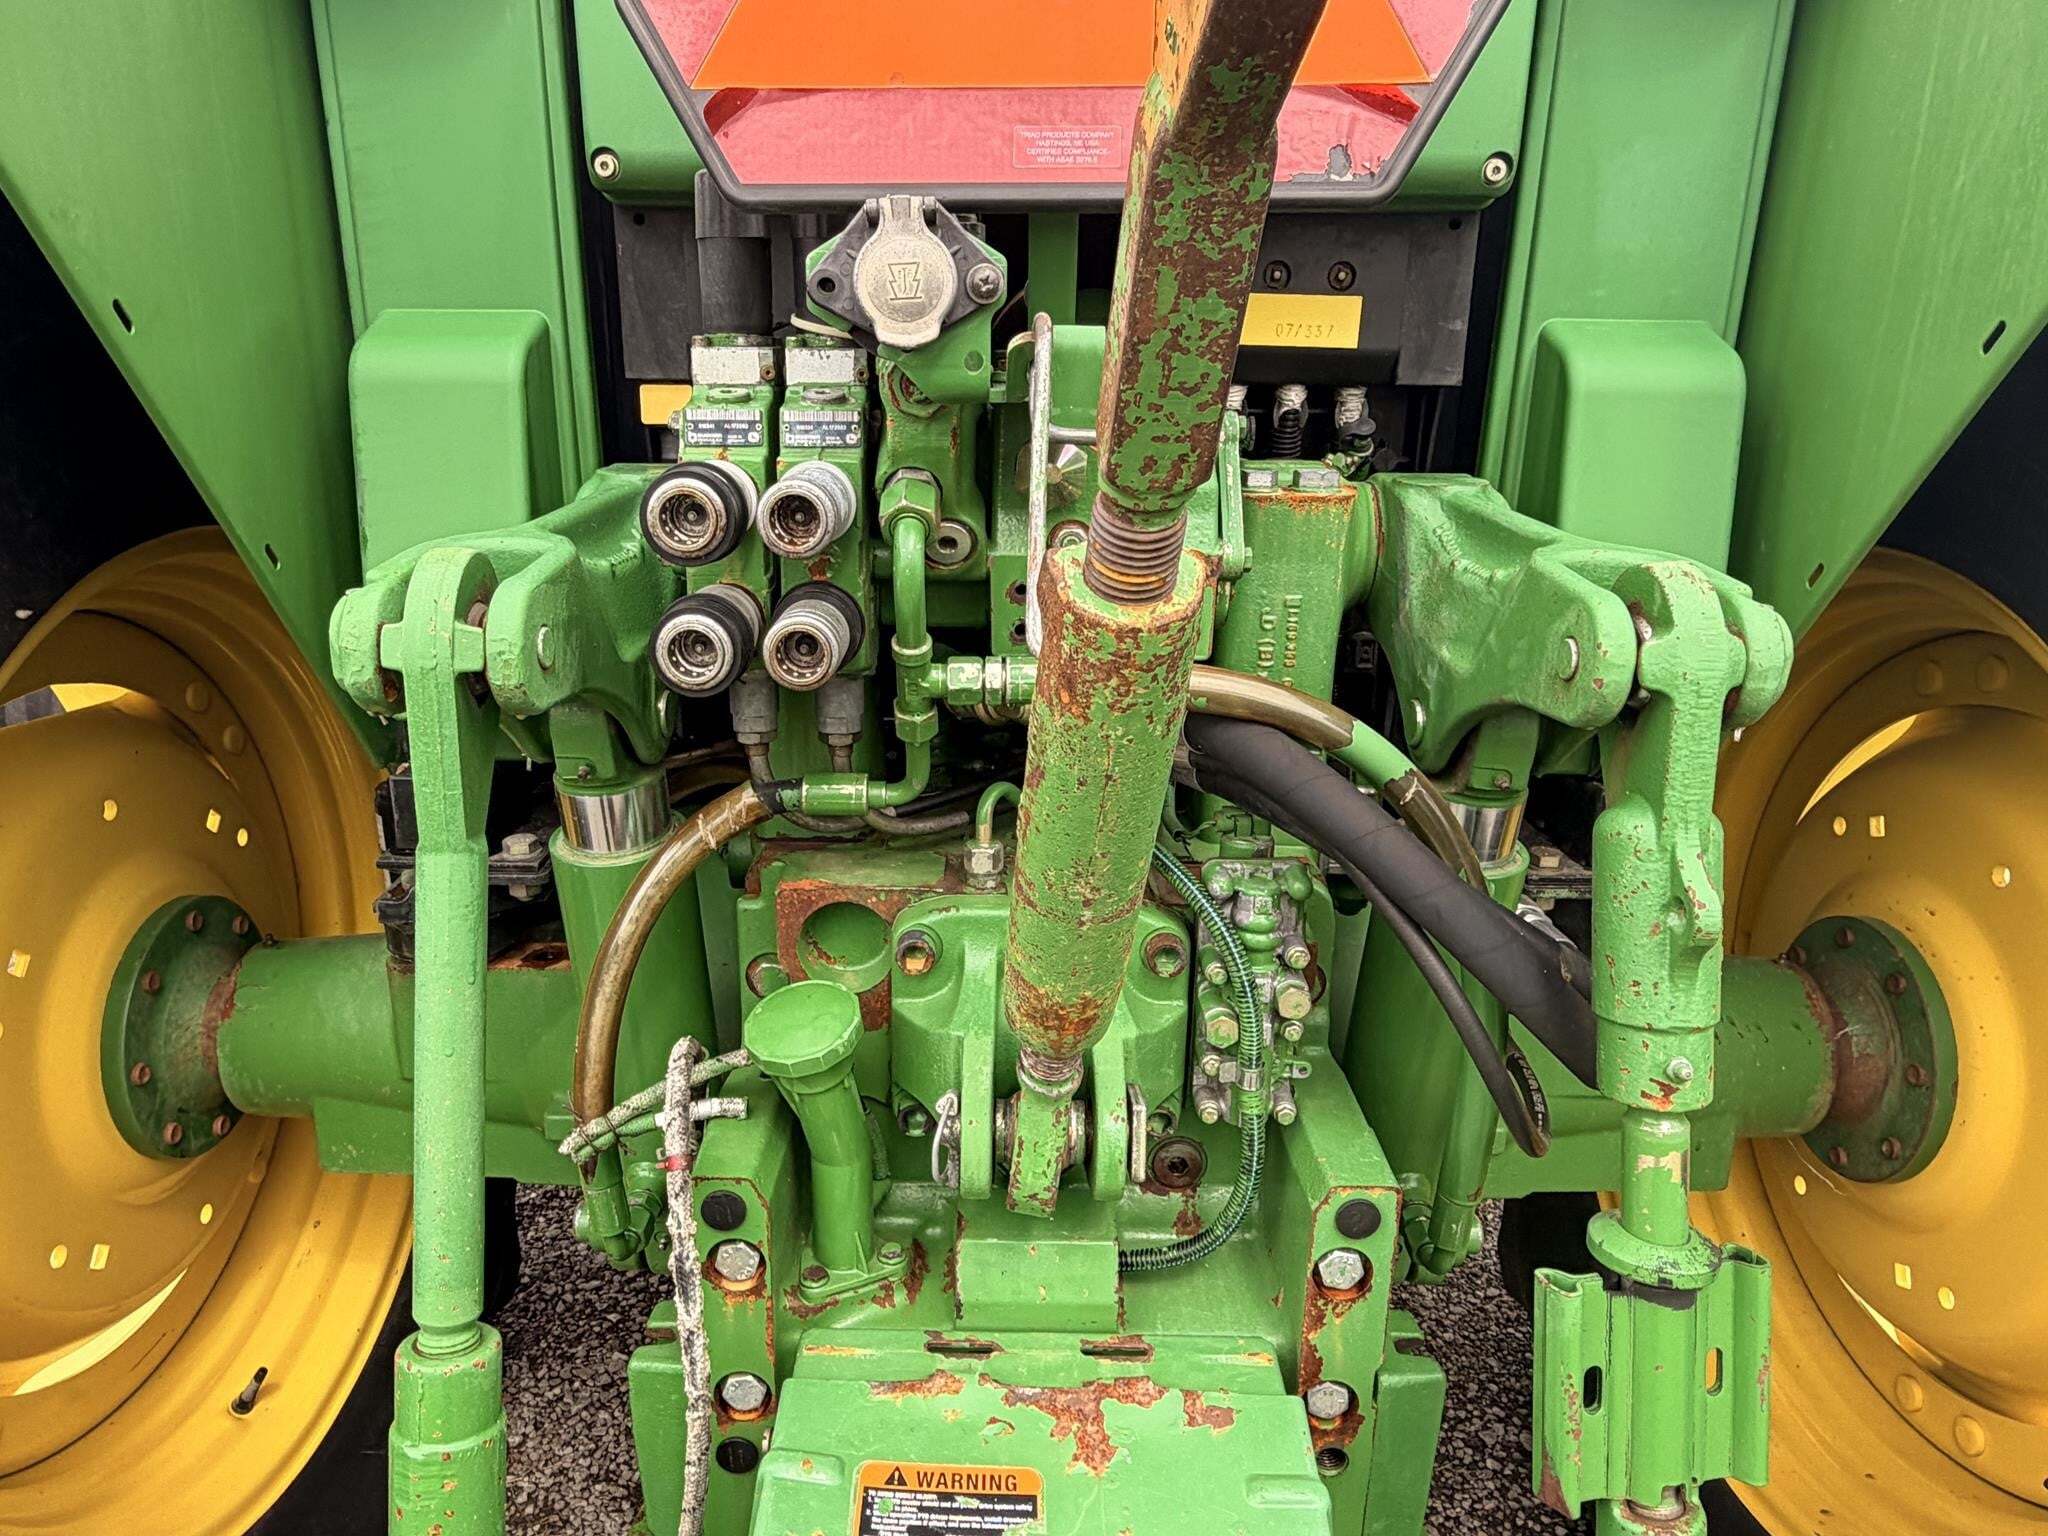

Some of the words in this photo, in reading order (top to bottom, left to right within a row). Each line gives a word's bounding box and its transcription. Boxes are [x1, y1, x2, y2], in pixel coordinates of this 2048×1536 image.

[1042, 131, 1080, 139] PRODUCTS
[1081, 131, 1113, 139] COMPANY
[917, 1470, 1018, 1492] WARNING
